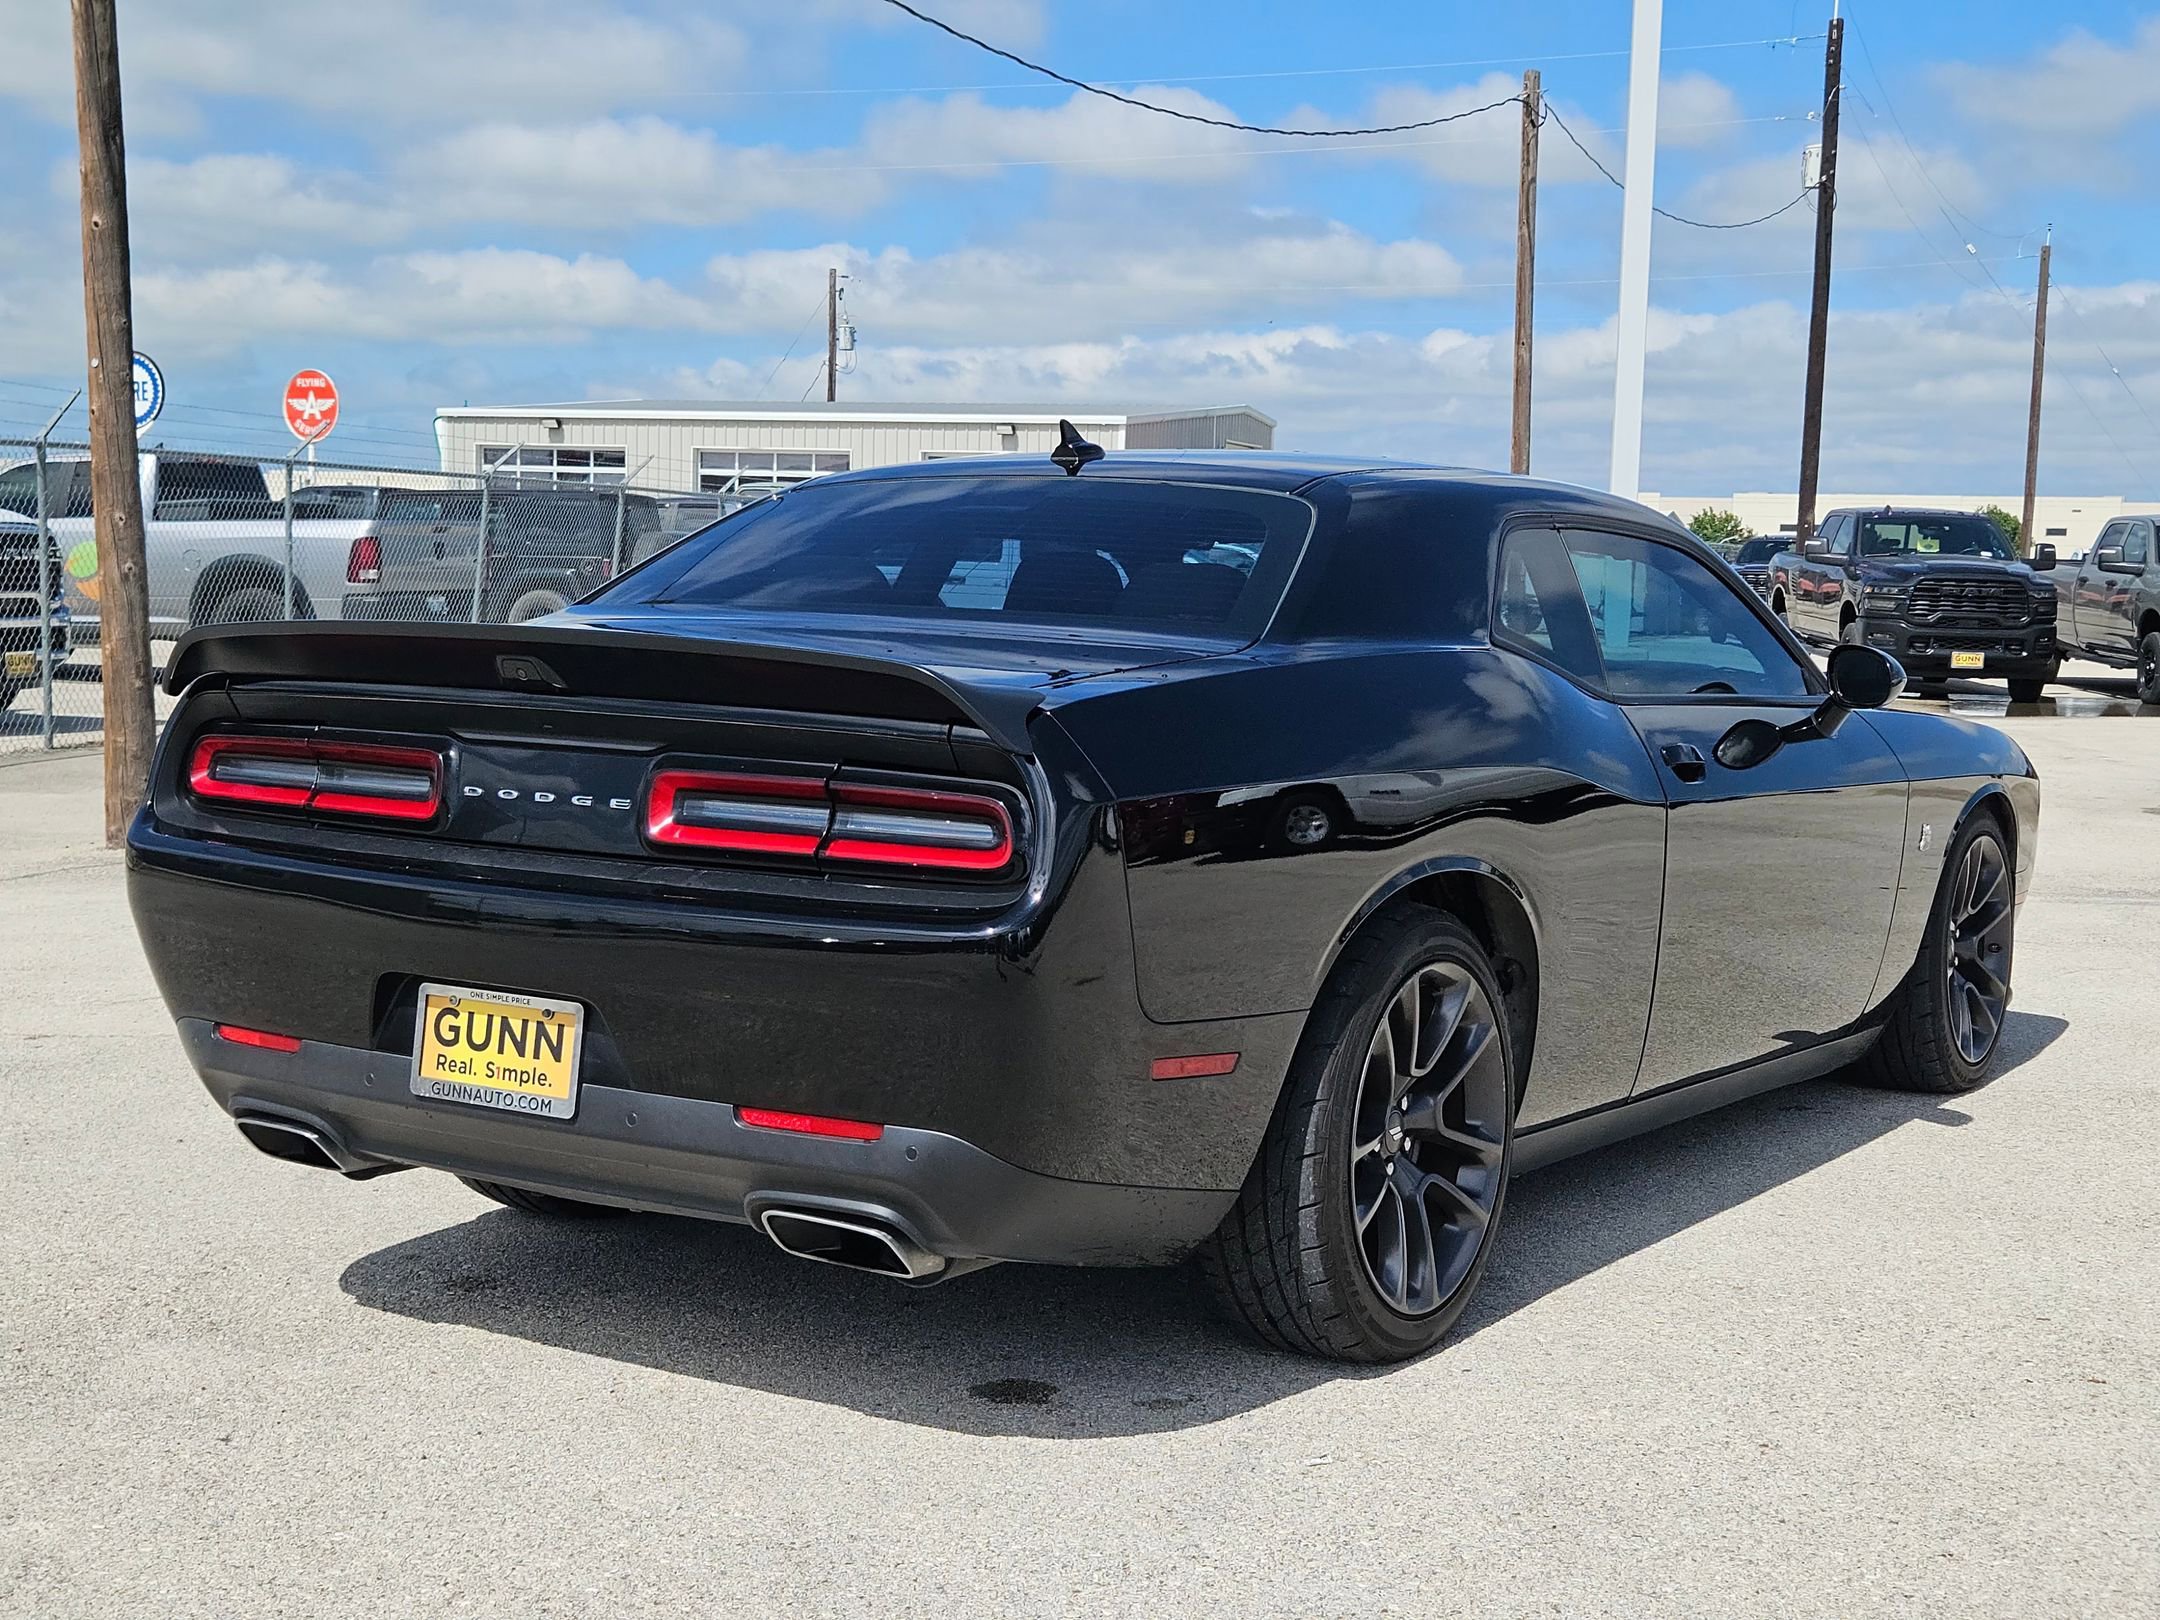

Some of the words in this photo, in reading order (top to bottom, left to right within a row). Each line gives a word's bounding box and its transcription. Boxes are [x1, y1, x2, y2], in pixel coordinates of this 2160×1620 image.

[132, 381, 148, 401] RE
[296, 378, 326, 387] FLYING
[463, 786, 632, 810] DODGE
[470, 991, 484, 1000] ONE
[486, 993, 510, 1003] SIMPLE
[511, 996, 532, 1006] PRICE
[433, 1007, 565, 1063] GUNN
[436, 1053, 477, 1076] Real.
[431, 1082, 552, 1113] GUNNAUTO.COM
